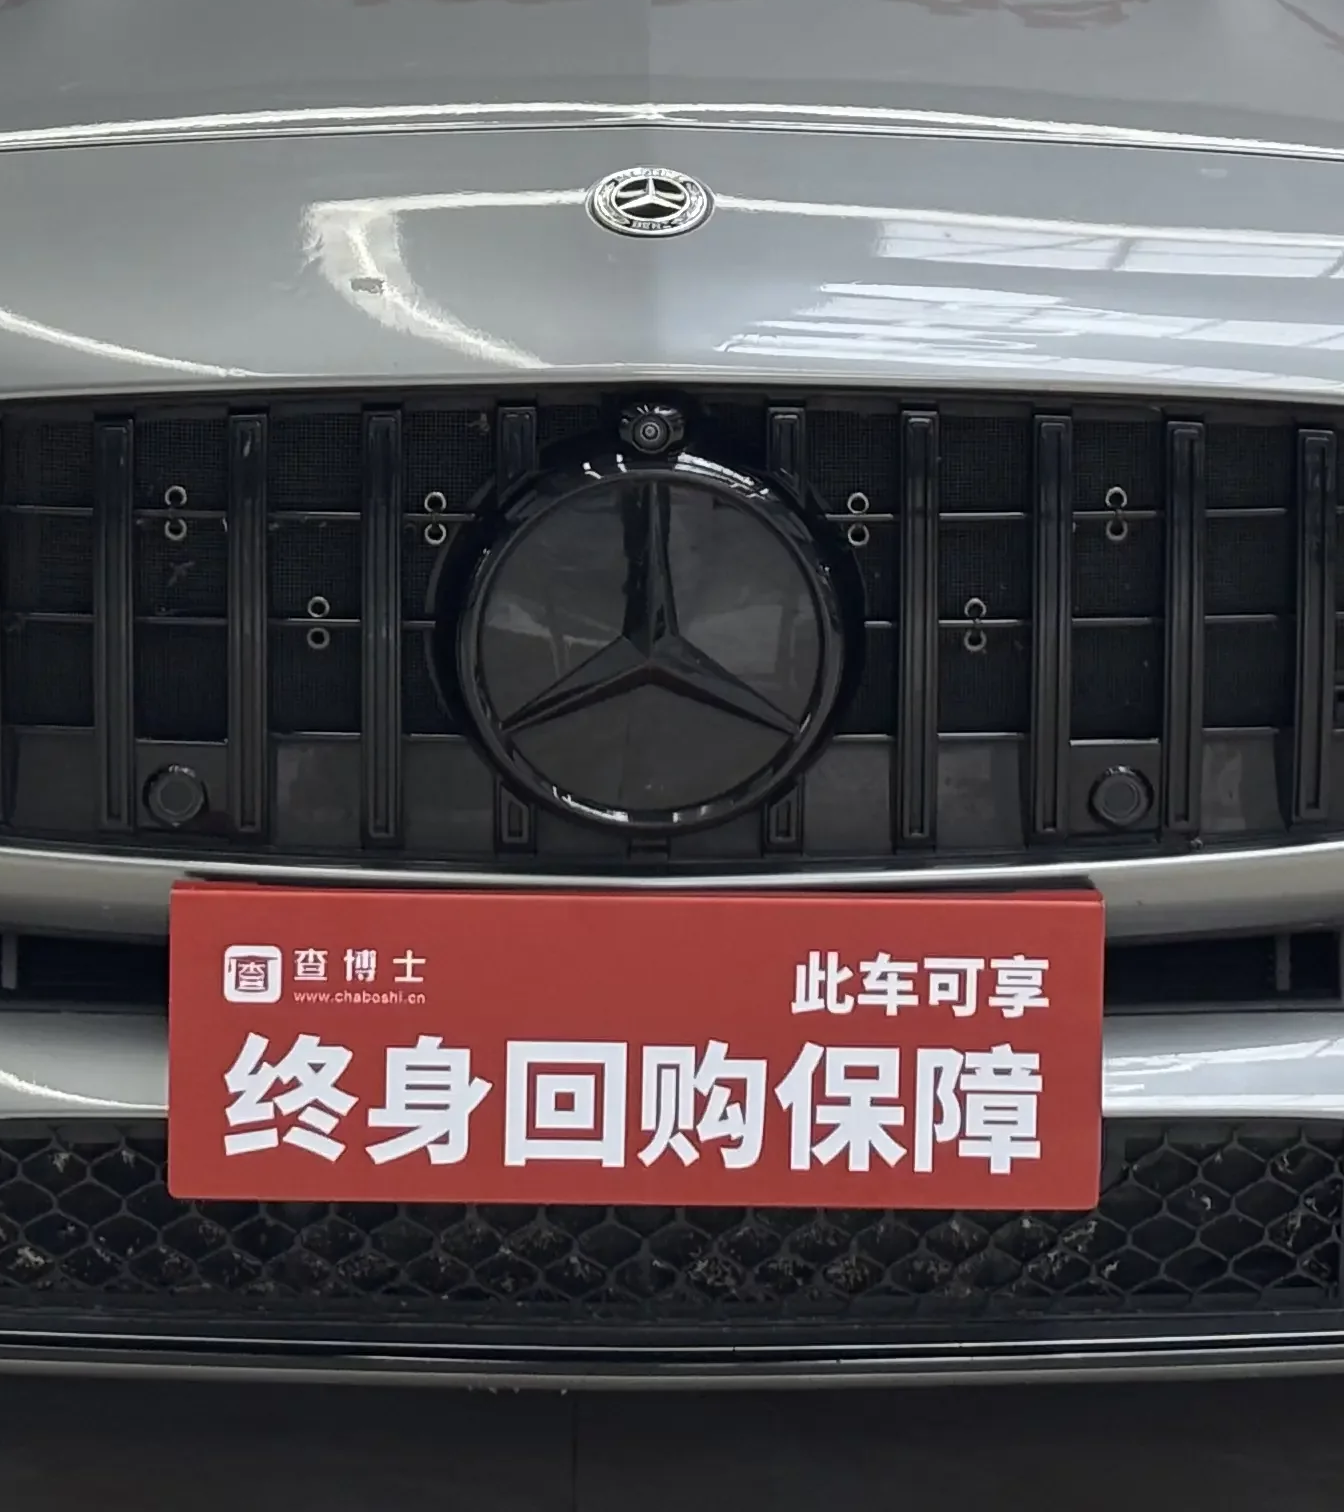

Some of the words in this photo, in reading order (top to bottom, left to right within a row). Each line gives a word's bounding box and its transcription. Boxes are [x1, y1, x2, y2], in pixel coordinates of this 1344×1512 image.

[293, 948, 427, 983] 查博士
[790, 950, 1051, 1019] 此车可享
[293, 989, 427, 1005] www.chaboshi.cn
[223, 1032, 1044, 1175] 终身回购保障
